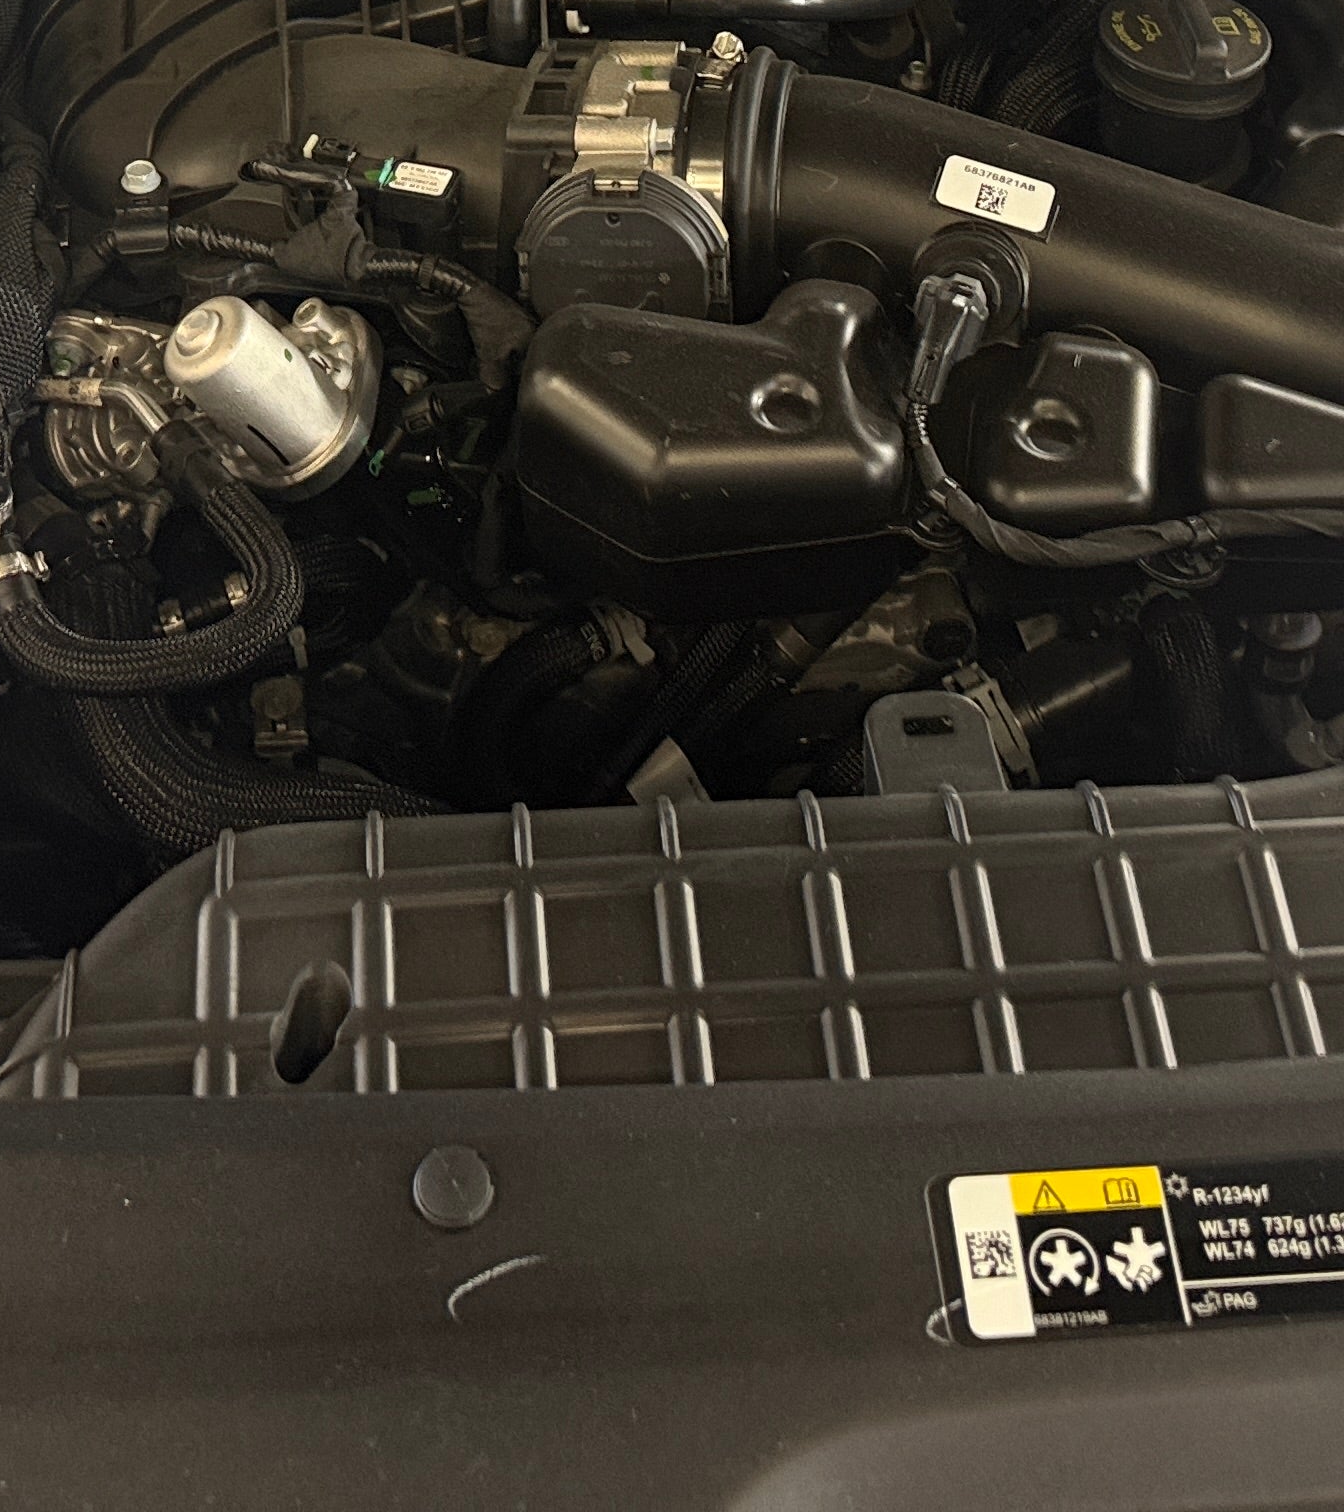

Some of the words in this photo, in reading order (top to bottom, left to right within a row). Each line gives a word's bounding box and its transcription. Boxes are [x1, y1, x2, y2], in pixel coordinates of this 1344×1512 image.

[1193, 1184, 1270, 1207] R-1234yf
[1199, 1217, 1251, 1239] WL75
[1262, 1215, 1306, 1238] 737g
[1204, 1240, 1256, 1262] WL74
[1267, 1237, 1312, 1260] 624g
[1223, 1291, 1257, 1310] PAG
